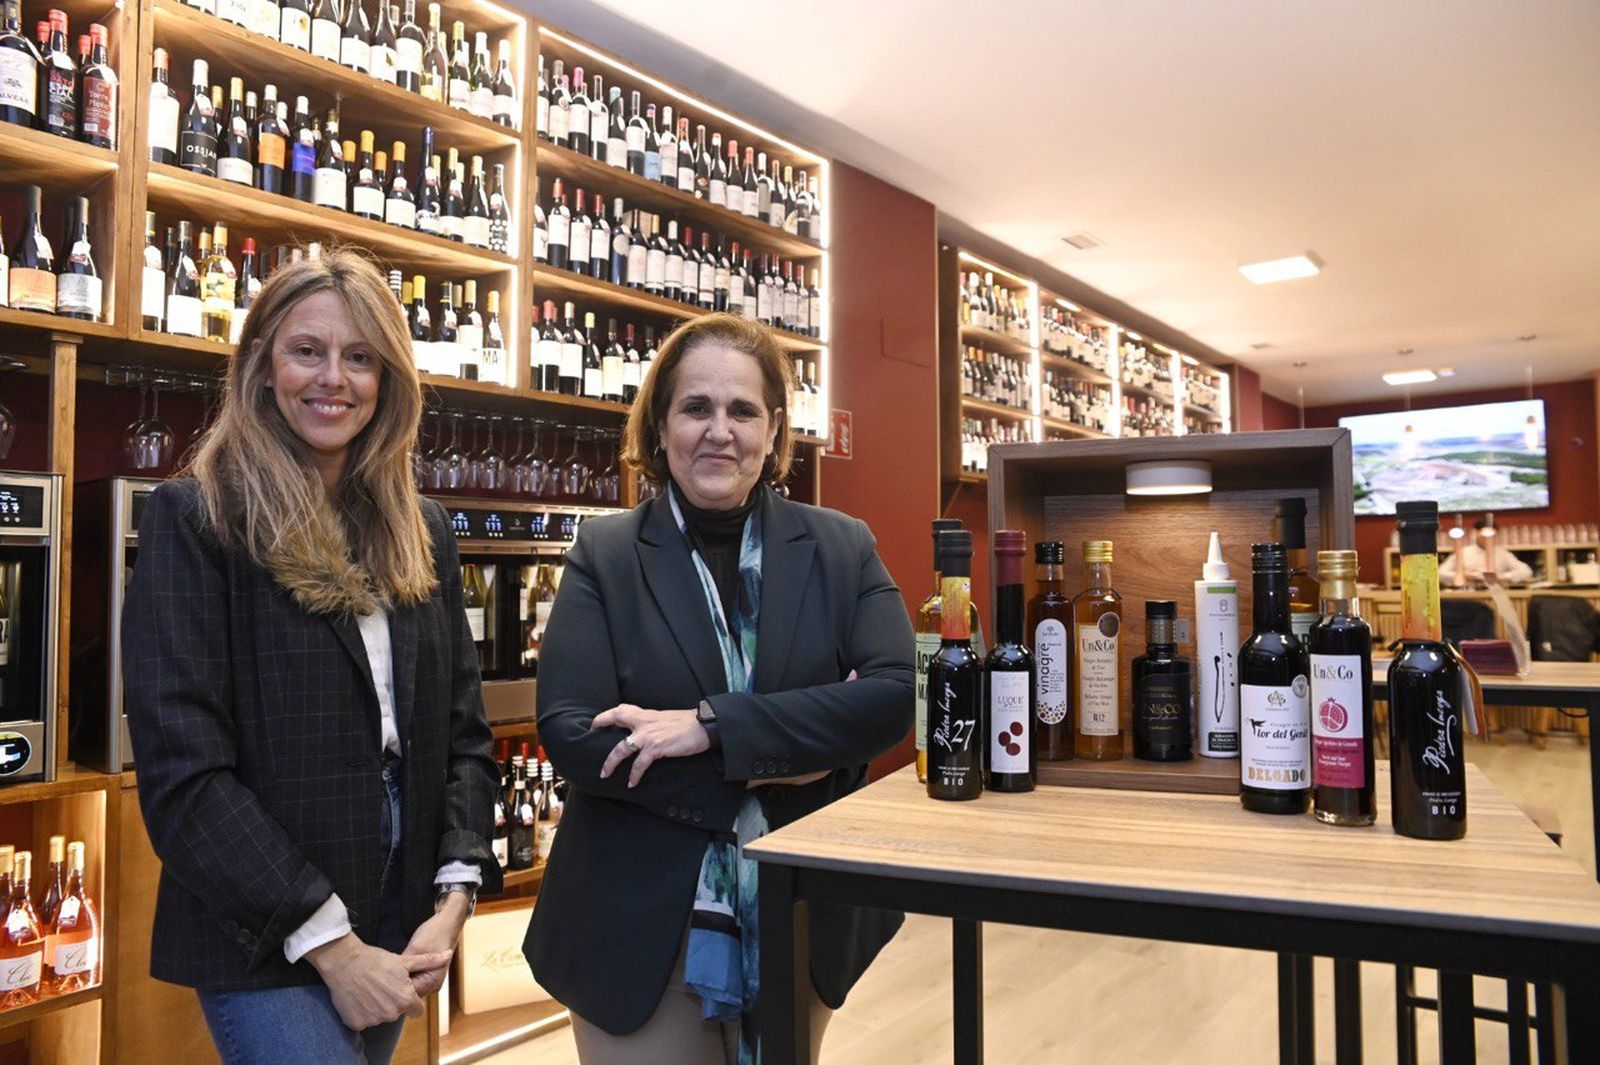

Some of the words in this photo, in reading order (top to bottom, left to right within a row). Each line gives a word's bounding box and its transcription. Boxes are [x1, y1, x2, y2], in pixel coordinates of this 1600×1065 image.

[0, 92, 30, 105] LVEAR
[1081, 638, 1115, 652] Un&Co
[1037, 643, 1054, 695] vinagre
[1313, 664, 1353, 680] Un&Co
[951, 719, 977, 752] 27
[1272, 728, 1288, 739] del
[1248, 766, 1307, 783] DELGADO
[943, 777, 965, 787] BIO
[1431, 805, 1456, 815] BIO
